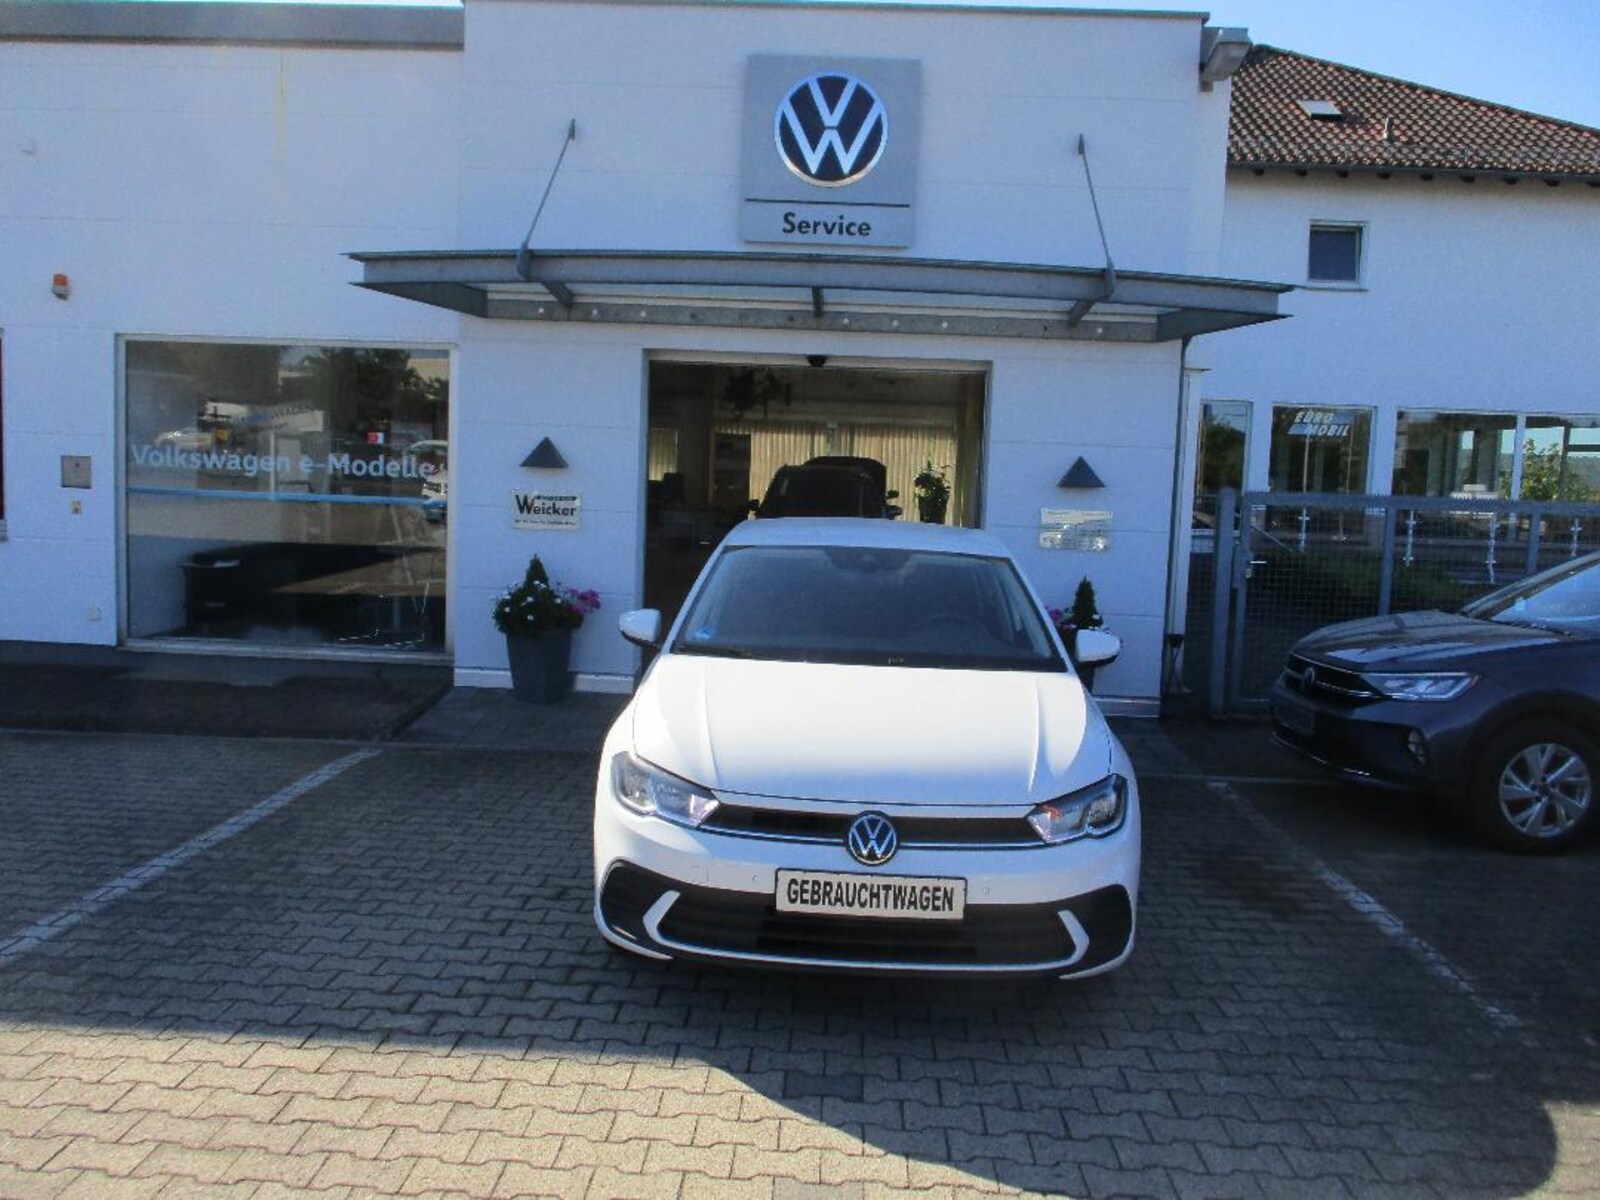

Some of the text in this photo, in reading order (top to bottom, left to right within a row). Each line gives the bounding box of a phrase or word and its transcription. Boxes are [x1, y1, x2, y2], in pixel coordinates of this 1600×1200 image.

[776, 72, 887, 186] VW
[782, 211, 871, 236] Service
[1306, 424, 1350, 436] MOBIL
[131, 444, 433, 479] Volkswagen e-Modelle
[515, 494, 577, 516] Weicker
[849, 814, 897, 864] VW
[787, 878, 954, 911] GEBRAUCHTWAGEN
